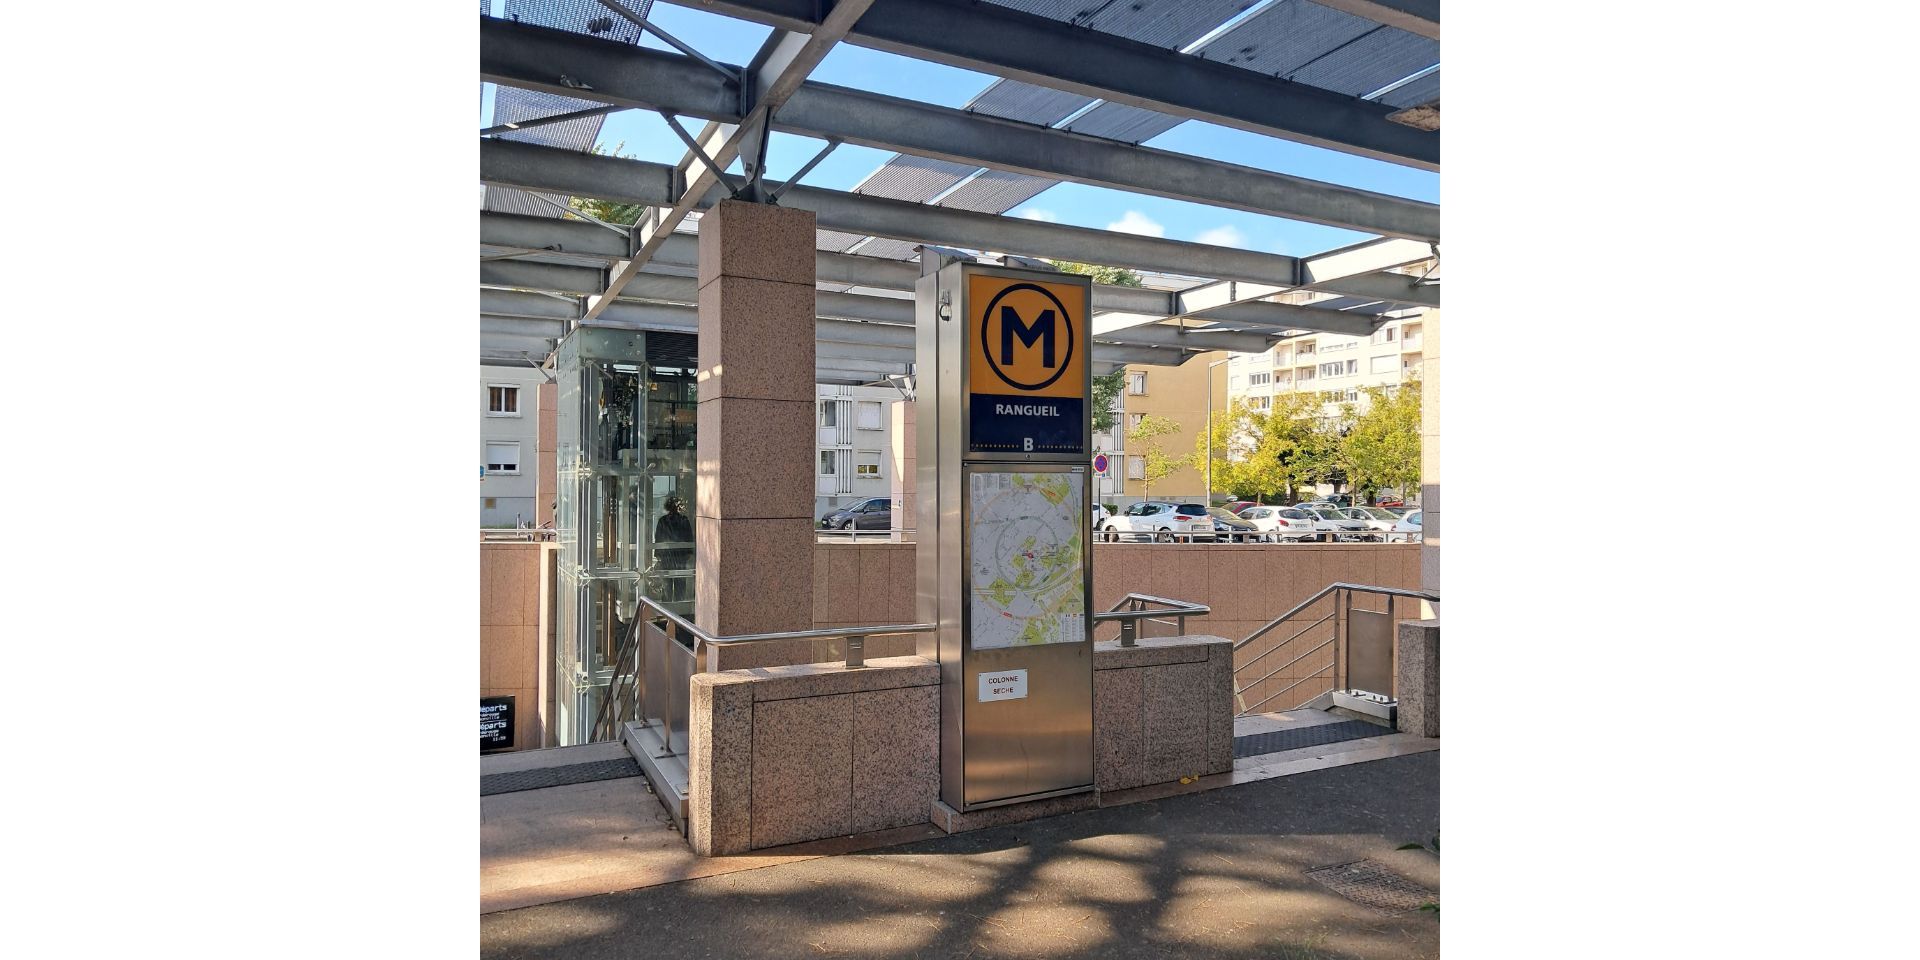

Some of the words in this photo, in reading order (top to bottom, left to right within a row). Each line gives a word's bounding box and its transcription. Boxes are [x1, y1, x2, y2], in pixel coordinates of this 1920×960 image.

[1001, 305, 1055, 368] M
[995, 403, 1060, 417] RANGUEIL
[1023, 437, 1034, 452] B
[988, 676, 1019, 684] COLONNE
[480, 721, 506, 730] éparts
